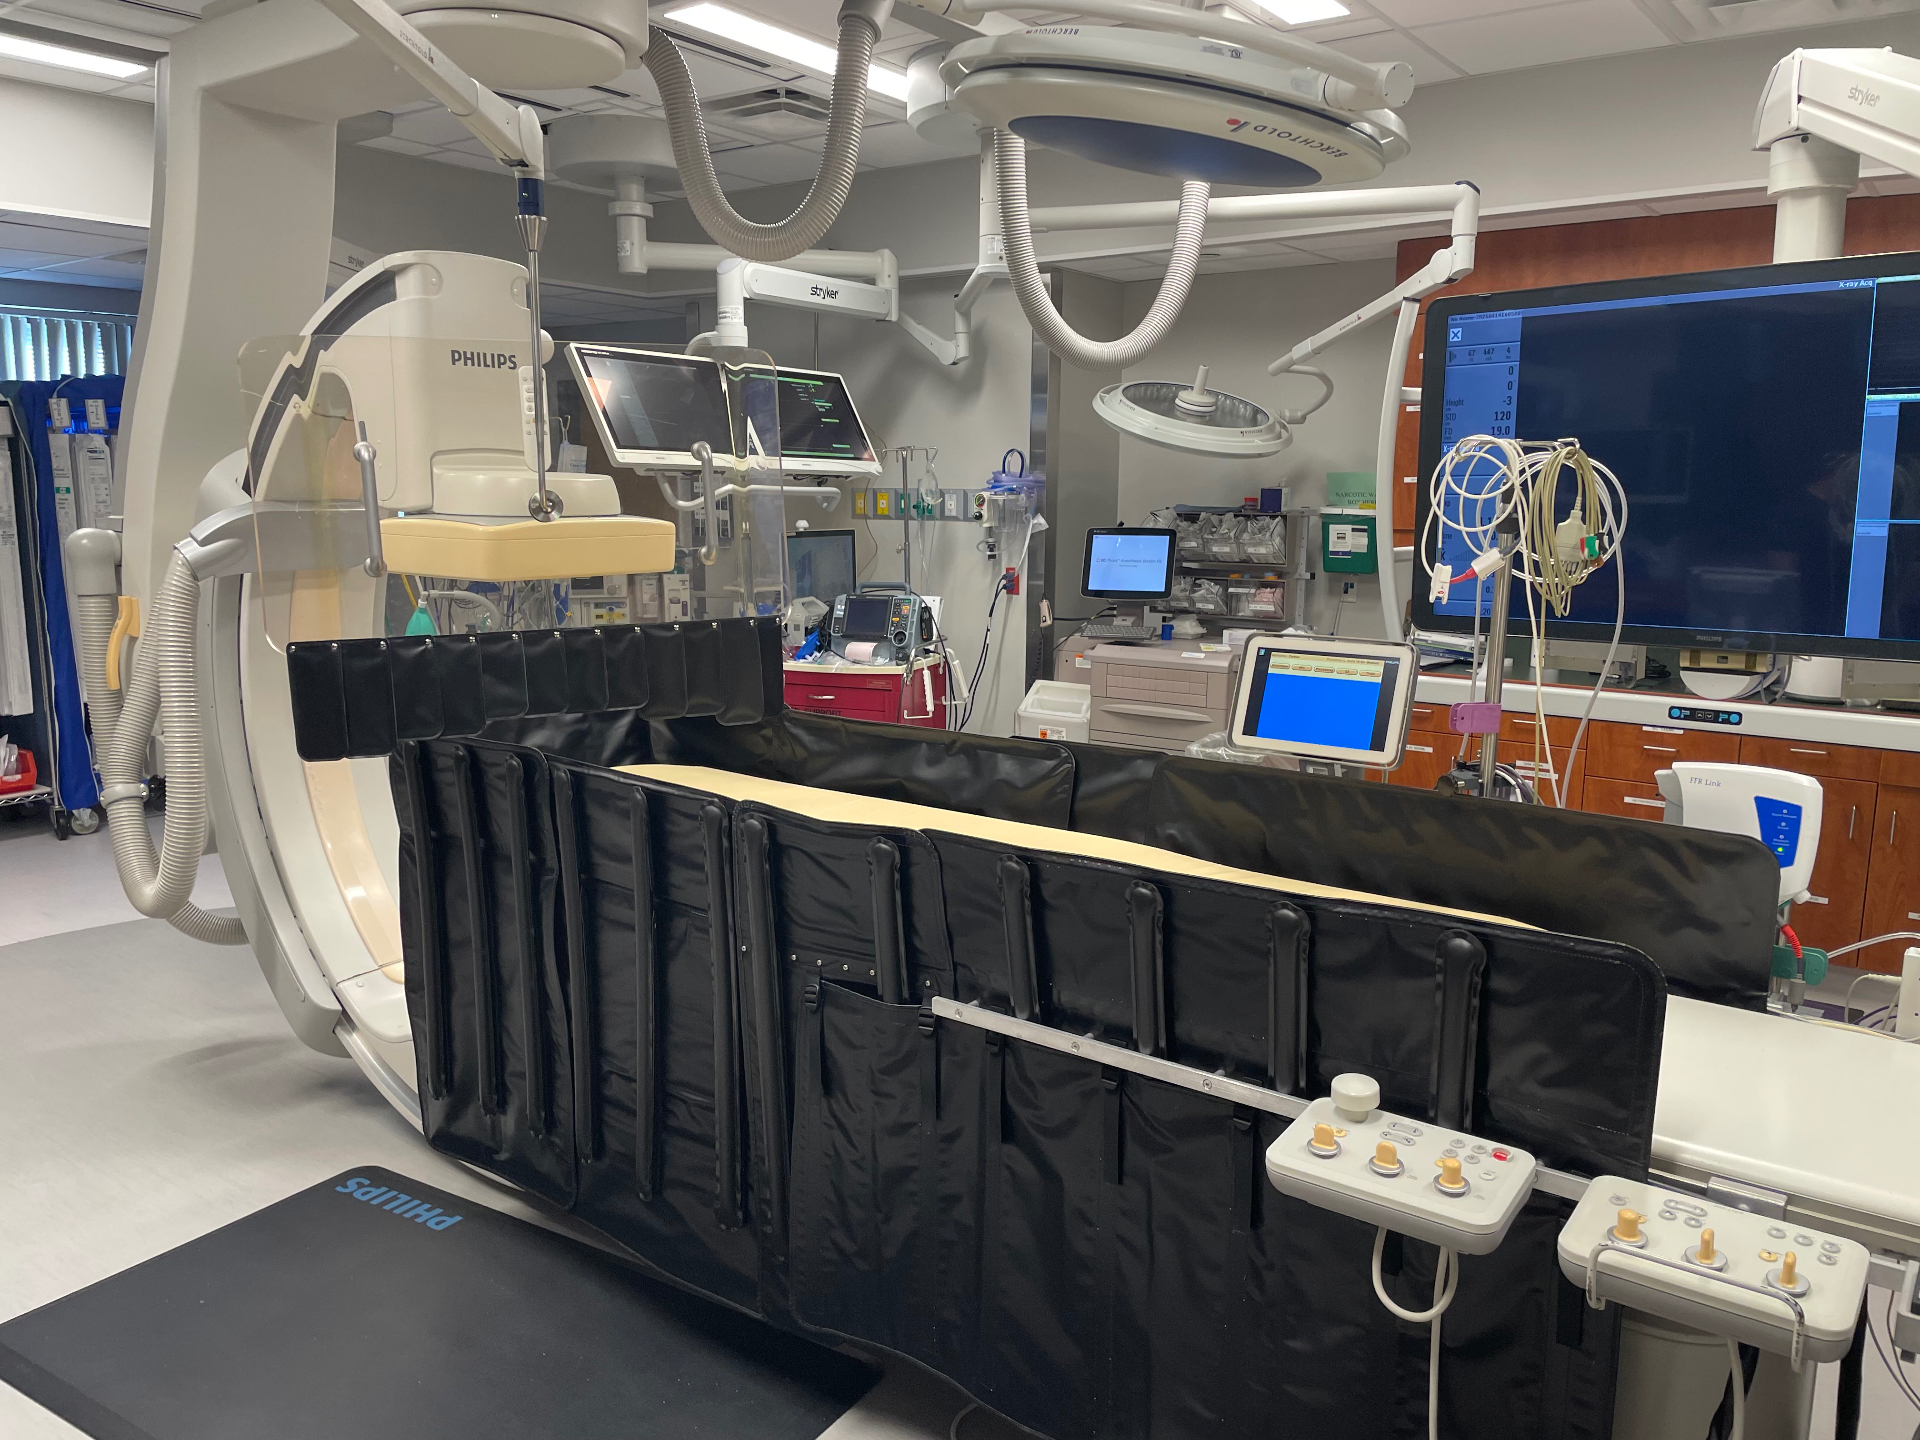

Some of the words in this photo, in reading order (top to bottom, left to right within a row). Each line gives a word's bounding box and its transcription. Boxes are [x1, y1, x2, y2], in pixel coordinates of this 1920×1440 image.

[1848, 84, 1881, 107] stryker
[1253, 124, 1349, 158] BERCHTOLD
[1839, 280, 1858, 288] X-ray
[1859, 279, 1873, 287] Acq
[810, 284, 839, 300] stryker
[450, 349, 518, 370] PHILIPS
[1446, 399, 1464, 407] Height
[1503, 396, 1512, 406] -3
[1494, 411, 1511, 421] 120
[1490, 425, 1510, 436] 19.0
[1689, 776, 1703, 785] FFR
[1705, 779, 1722, 787] Link
[335, 1177, 463, 1231] PHILIPS
